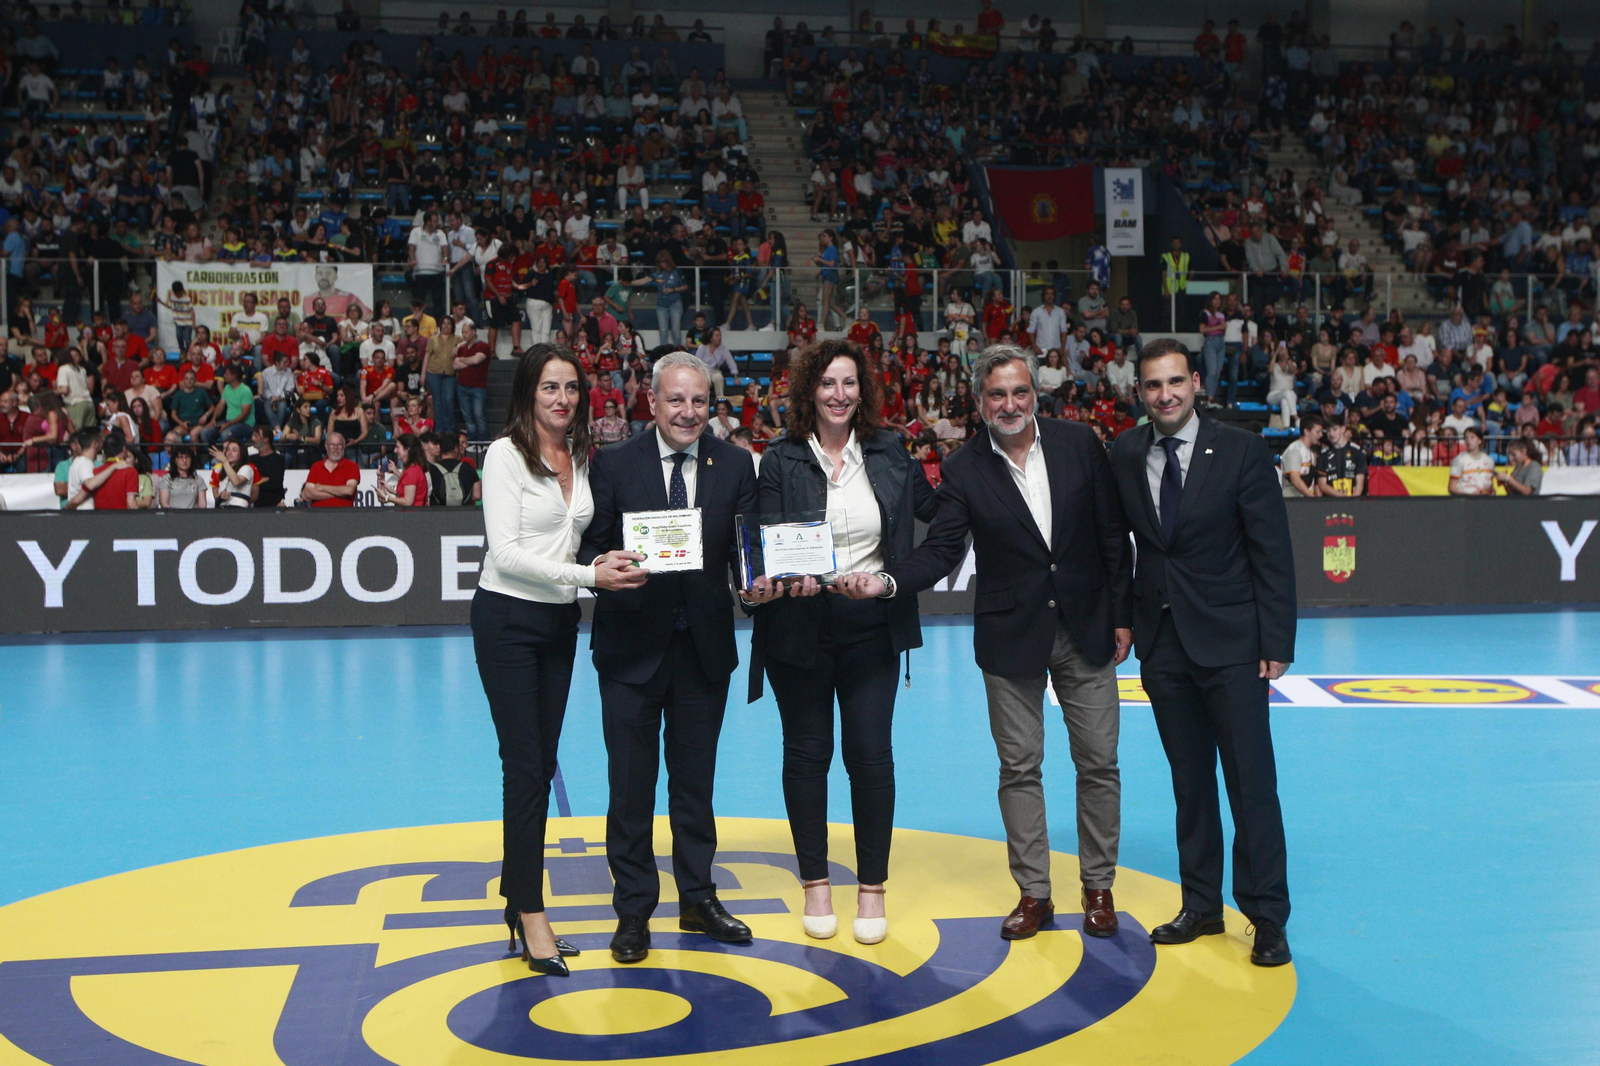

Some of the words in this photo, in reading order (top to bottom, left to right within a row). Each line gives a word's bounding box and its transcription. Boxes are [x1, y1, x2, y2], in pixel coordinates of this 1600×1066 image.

[1113, 219, 1137, 228] BAM
[187, 271, 256, 284] CARBONERAS
[258, 271, 279, 283] CON
[167, 287, 235, 306] USTÍN
[1541, 520, 1599, 581] Y
[16, 539, 90, 608] Y
[112, 535, 414, 607] TODO
